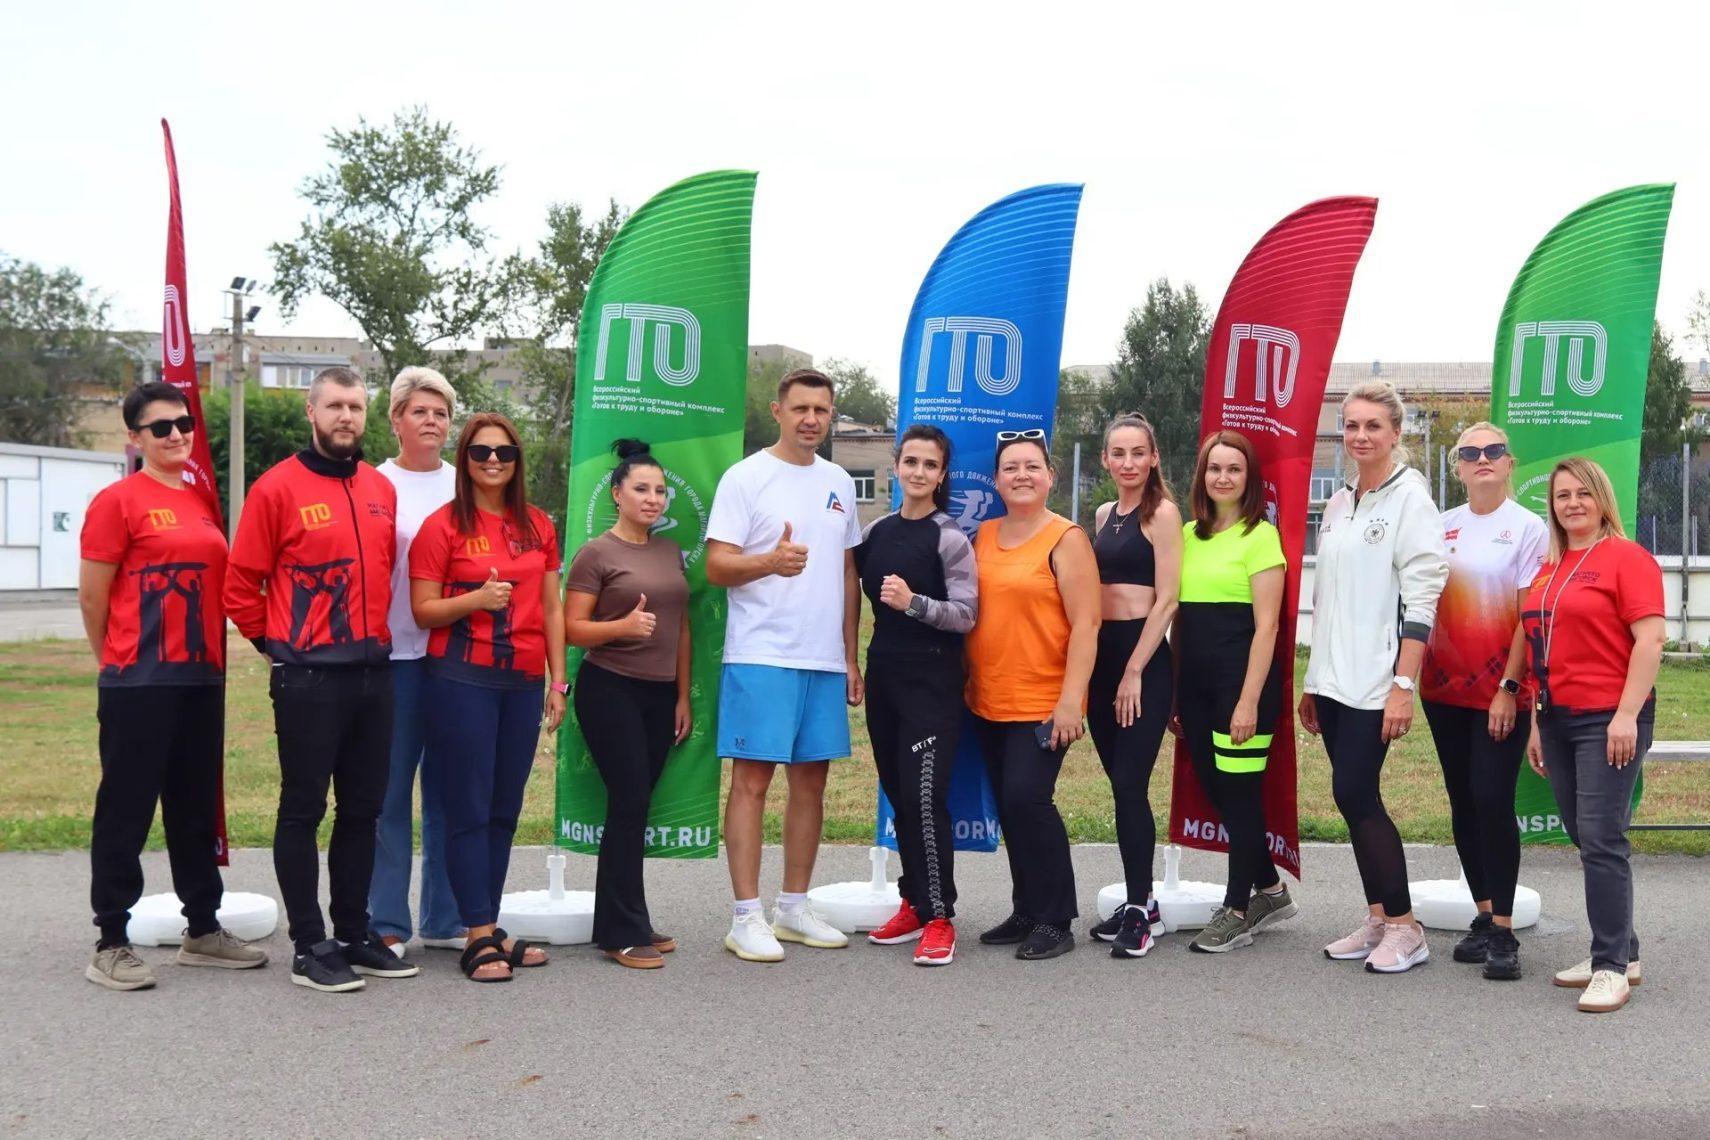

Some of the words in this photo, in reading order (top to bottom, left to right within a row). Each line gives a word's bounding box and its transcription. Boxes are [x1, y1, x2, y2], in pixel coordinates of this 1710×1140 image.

[594, 303, 701, 387] ГТО
[915, 316, 1023, 396] ГТО
[1224, 323, 1300, 408] ГТО
[1509, 320, 1608, 397] ГТО
[617, 404, 638, 413] труду
[687, 403, 725, 414] комплекс
[1007, 412, 1044, 421] комплекс
[561, 816, 712, 847] MGNSRT.RU
